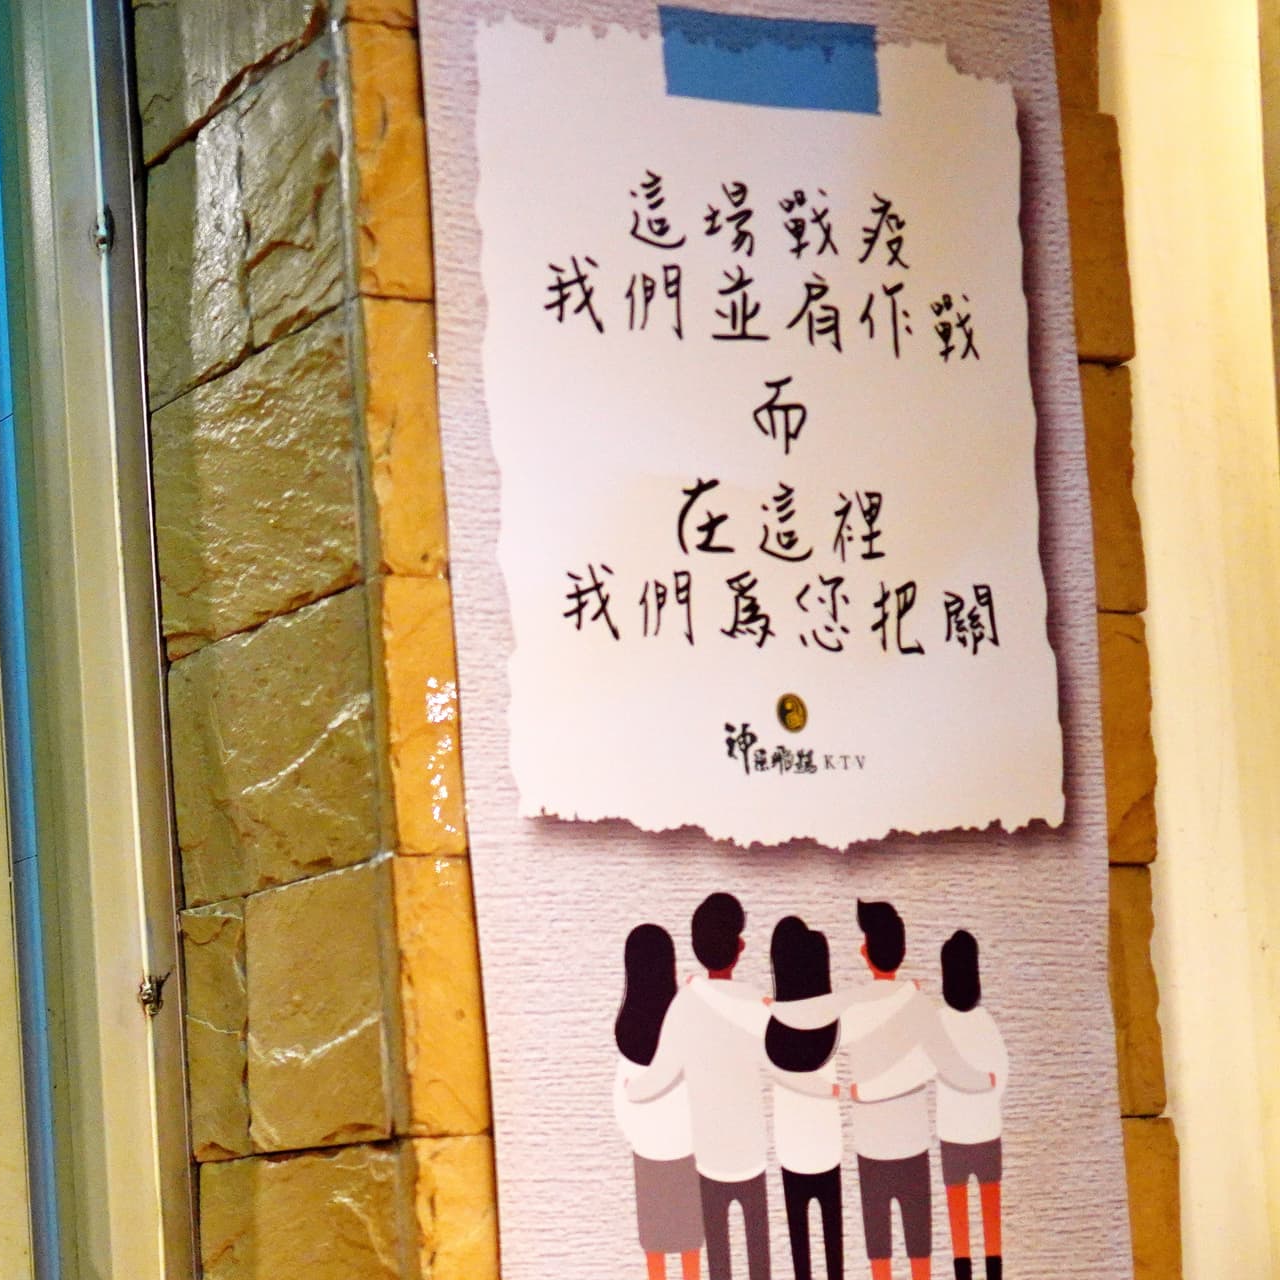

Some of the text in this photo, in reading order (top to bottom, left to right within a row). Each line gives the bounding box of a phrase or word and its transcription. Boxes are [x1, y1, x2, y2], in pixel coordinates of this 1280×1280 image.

[630, 170, 910, 270] 這場戰疫
[544, 256, 980, 363] 我們並肩作戰
[753, 376, 807, 455] 而
[677, 478, 886, 563] 在這裡
